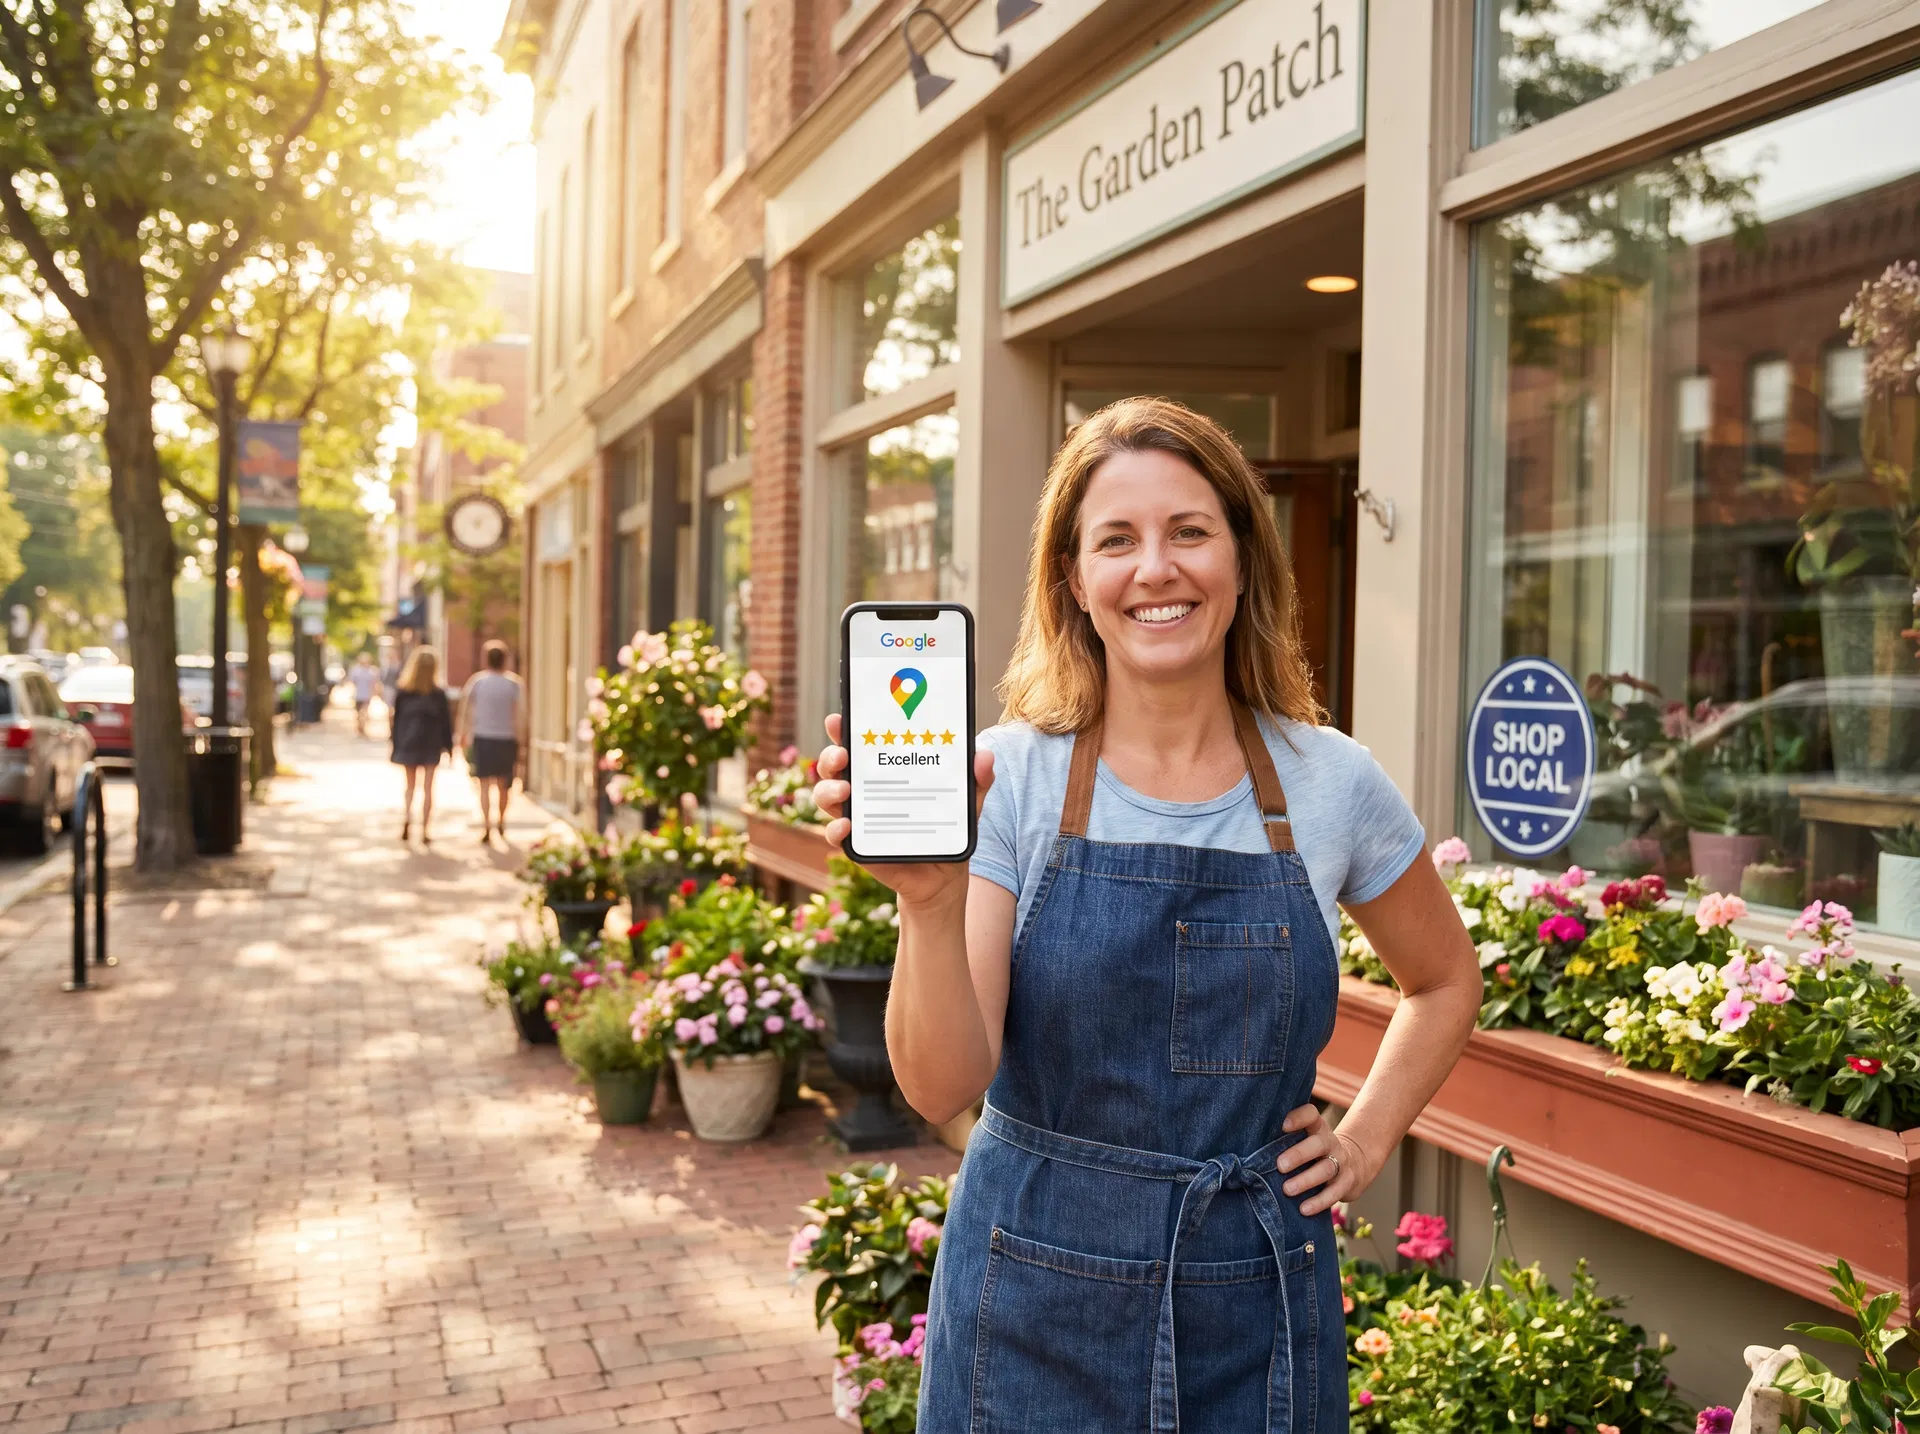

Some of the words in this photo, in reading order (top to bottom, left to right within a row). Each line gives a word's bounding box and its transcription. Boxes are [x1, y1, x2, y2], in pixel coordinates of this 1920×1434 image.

[1016, 176, 1070, 249] The
[1079, 104, 1206, 212] Garden
[1218, 1, 1344, 140] Patch
[880, 632, 937, 651] Google
[1493, 721, 1565, 755] SHOP
[878, 752, 941, 766] Excellent
[1486, 756, 1571, 794] LOCAL
